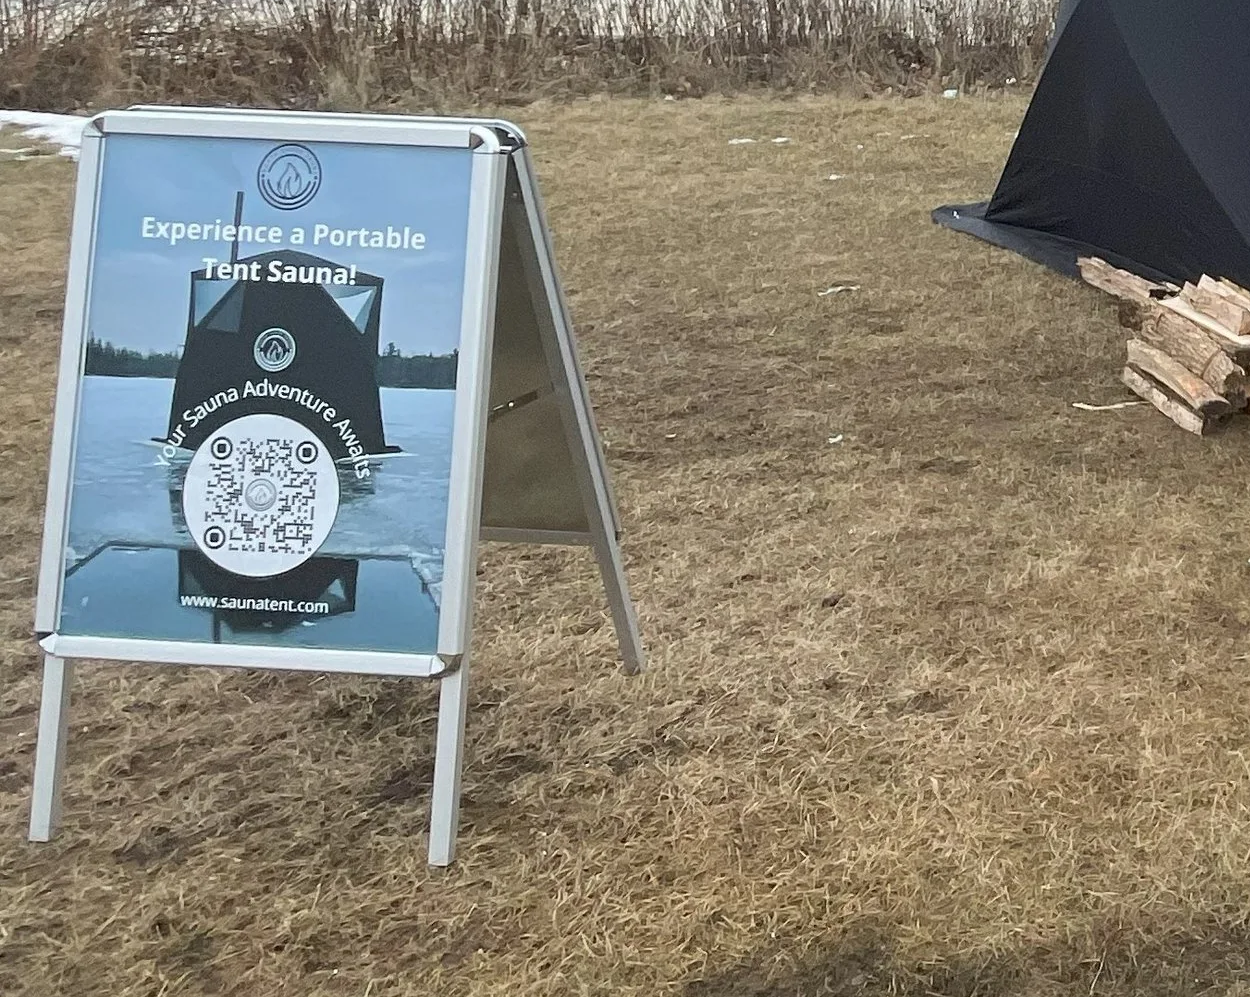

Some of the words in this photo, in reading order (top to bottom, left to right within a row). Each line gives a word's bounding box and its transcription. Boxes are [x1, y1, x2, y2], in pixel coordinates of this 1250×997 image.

[141, 216, 282, 246] Experience
[290, 227, 305, 245] a
[313, 224, 426, 250] Portable
[202, 257, 262, 282] Tent
[267, 259, 357, 285] Sauna!
[154, 423, 187, 467] Your
[182, 387, 239, 428] Sauna
[242, 378, 337, 422] Adventure
[332, 418, 371, 479] Awaits
[180, 594, 330, 614] www.saunatent.com
